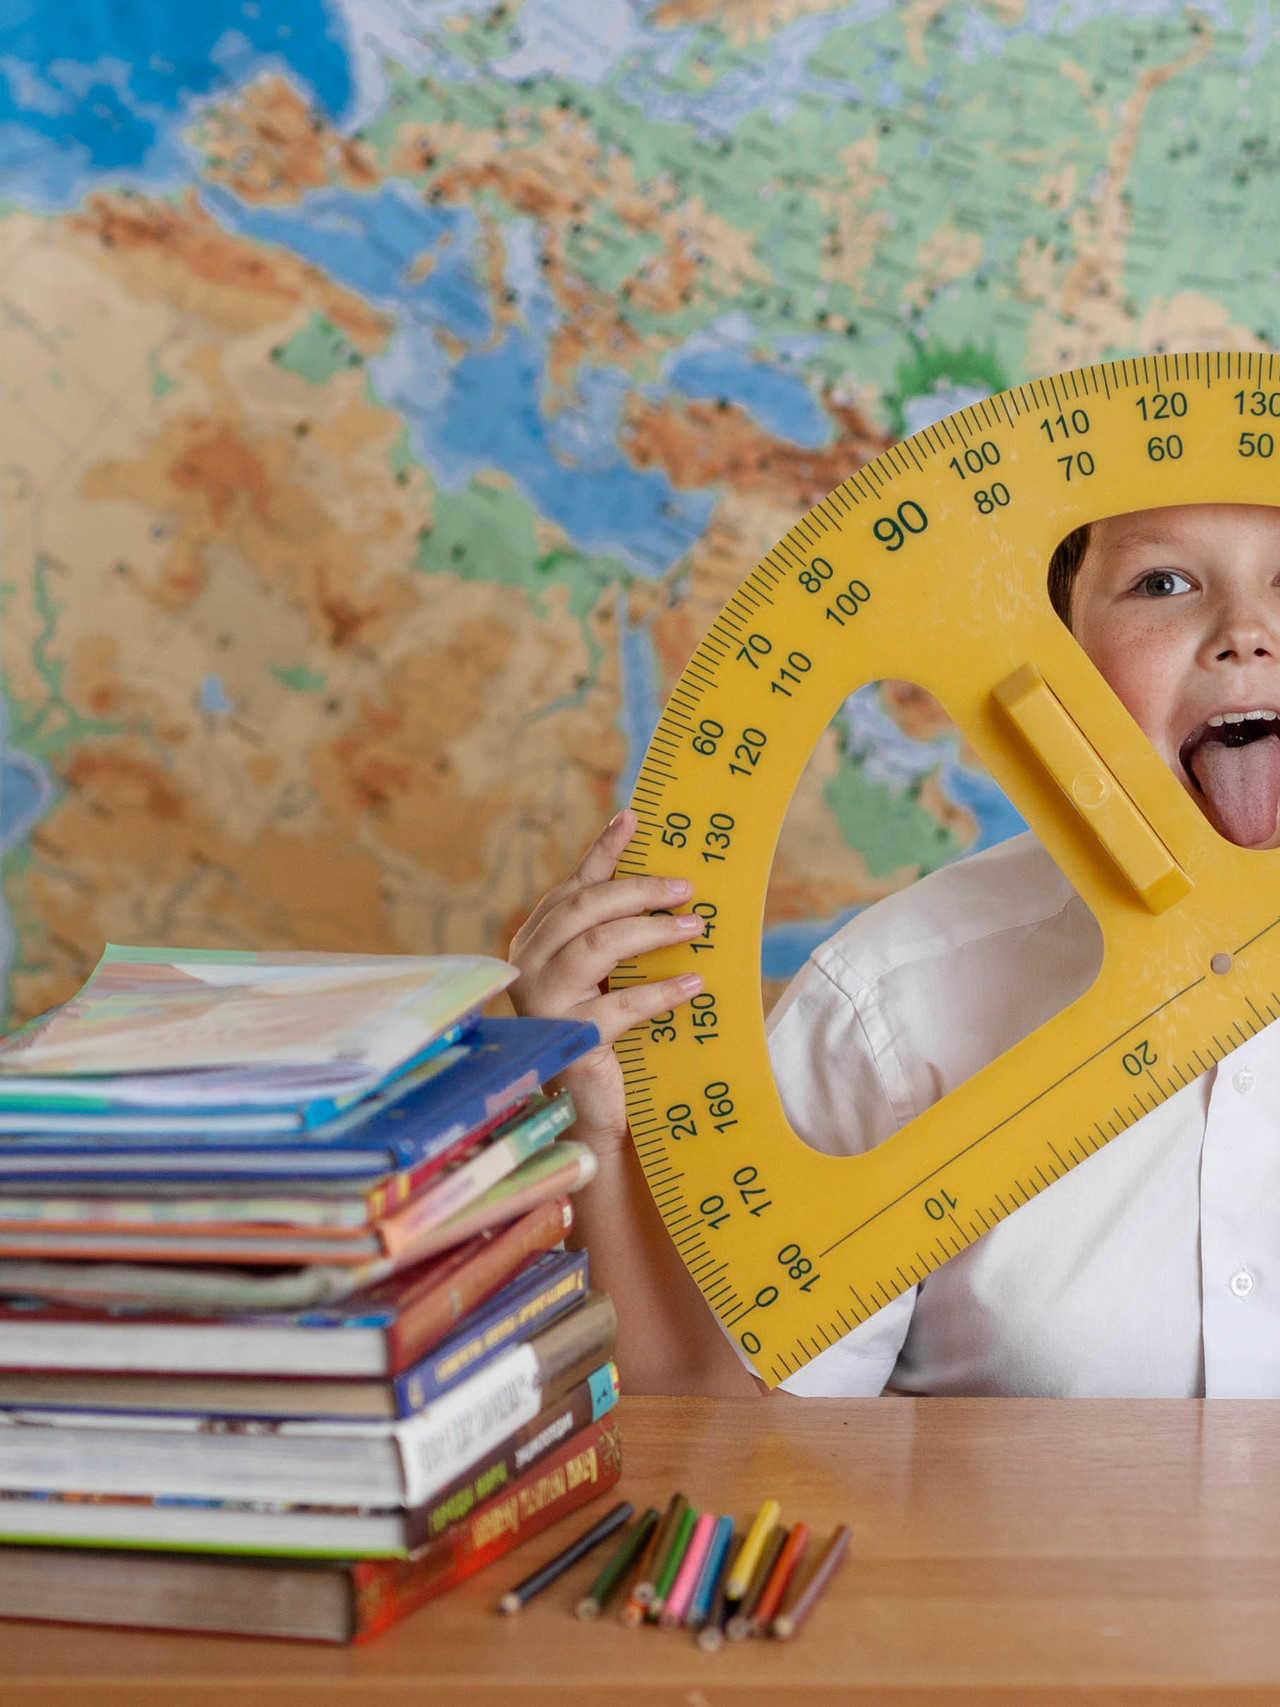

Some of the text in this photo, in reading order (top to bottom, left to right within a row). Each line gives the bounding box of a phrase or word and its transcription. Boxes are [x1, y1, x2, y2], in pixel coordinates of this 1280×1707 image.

[1135, 391, 1188, 421] 120
[1039, 409, 1090, 443] 110
[949, 441, 1001, 480] 100
[1147, 434, 1183, 462] 60
[1238, 432, 1275, 459] 50
[1057, 451, 1095, 482] 70
[973, 482, 1011, 515] 80
[872, 500, 929, 552] 90
[798, 557, 834, 594] 80
[826, 579, 871, 626] 100
[735, 633, 773, 670] 70
[770, 651, 812, 697] 110
[691, 719, 724, 756] 60
[728, 727, 767, 776] 120
[660, 812, 692, 849] 50
[701, 813, 735, 863] 130
[689, 902, 718, 954] 140
[689, 992, 719, 1045] 150
[1122, 1040, 1158, 1076] 20
[667, 1103, 698, 1141] 20
[703, 1081, 739, 1134] 160
[733, 1165, 773, 1217] 170
[924, 1189, 957, 1221] 10
[699, 1194, 731, 1230] 10
[777, 1243, 821, 1293] 180
[755, 1286, 779, 1309] 0
[740, 1331, 762, 1355] 0
